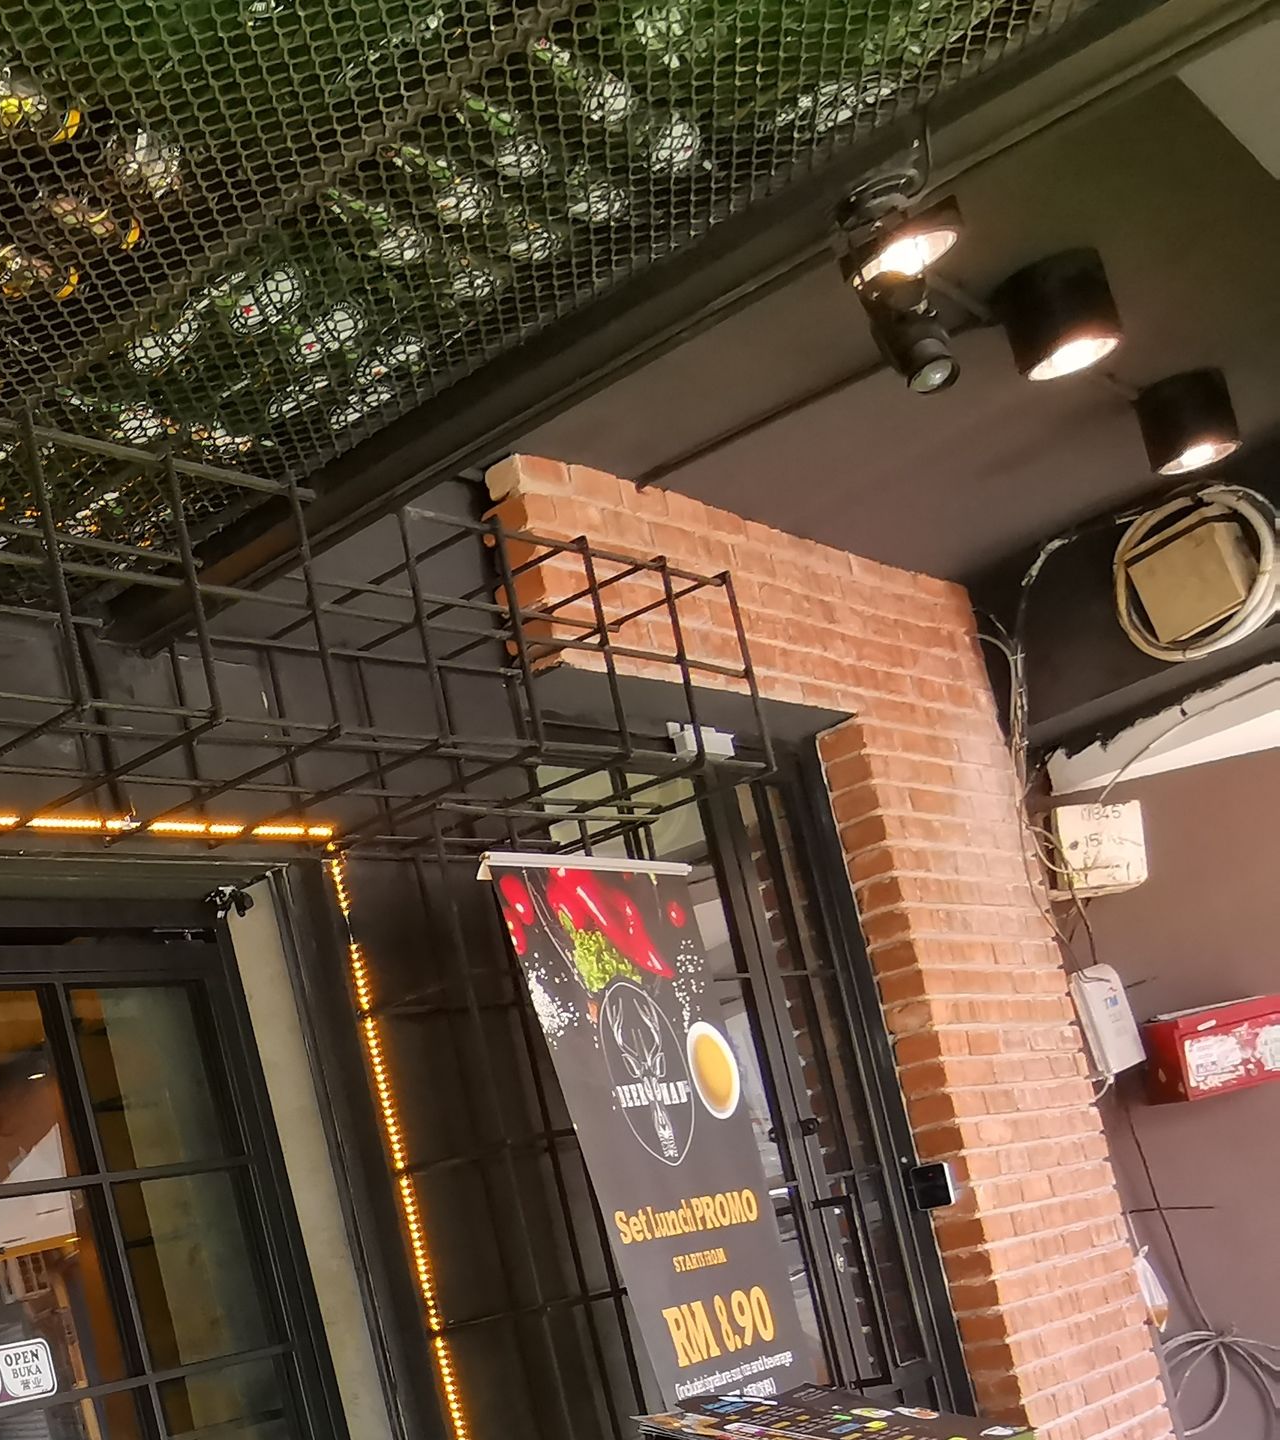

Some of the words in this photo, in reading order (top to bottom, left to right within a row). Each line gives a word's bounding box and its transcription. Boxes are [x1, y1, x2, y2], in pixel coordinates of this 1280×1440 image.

[614, 1207, 653, 1245] Set
[647, 1199, 698, 1239] Lunch
[690, 1188, 758, 1231] PROMO
[661, 1300, 721, 1368] RM
[713, 1285, 775, 1353] 8.90
[4, 1349, 40, 1367] OPEN
[11, 1364, 42, 1379] BUKA
